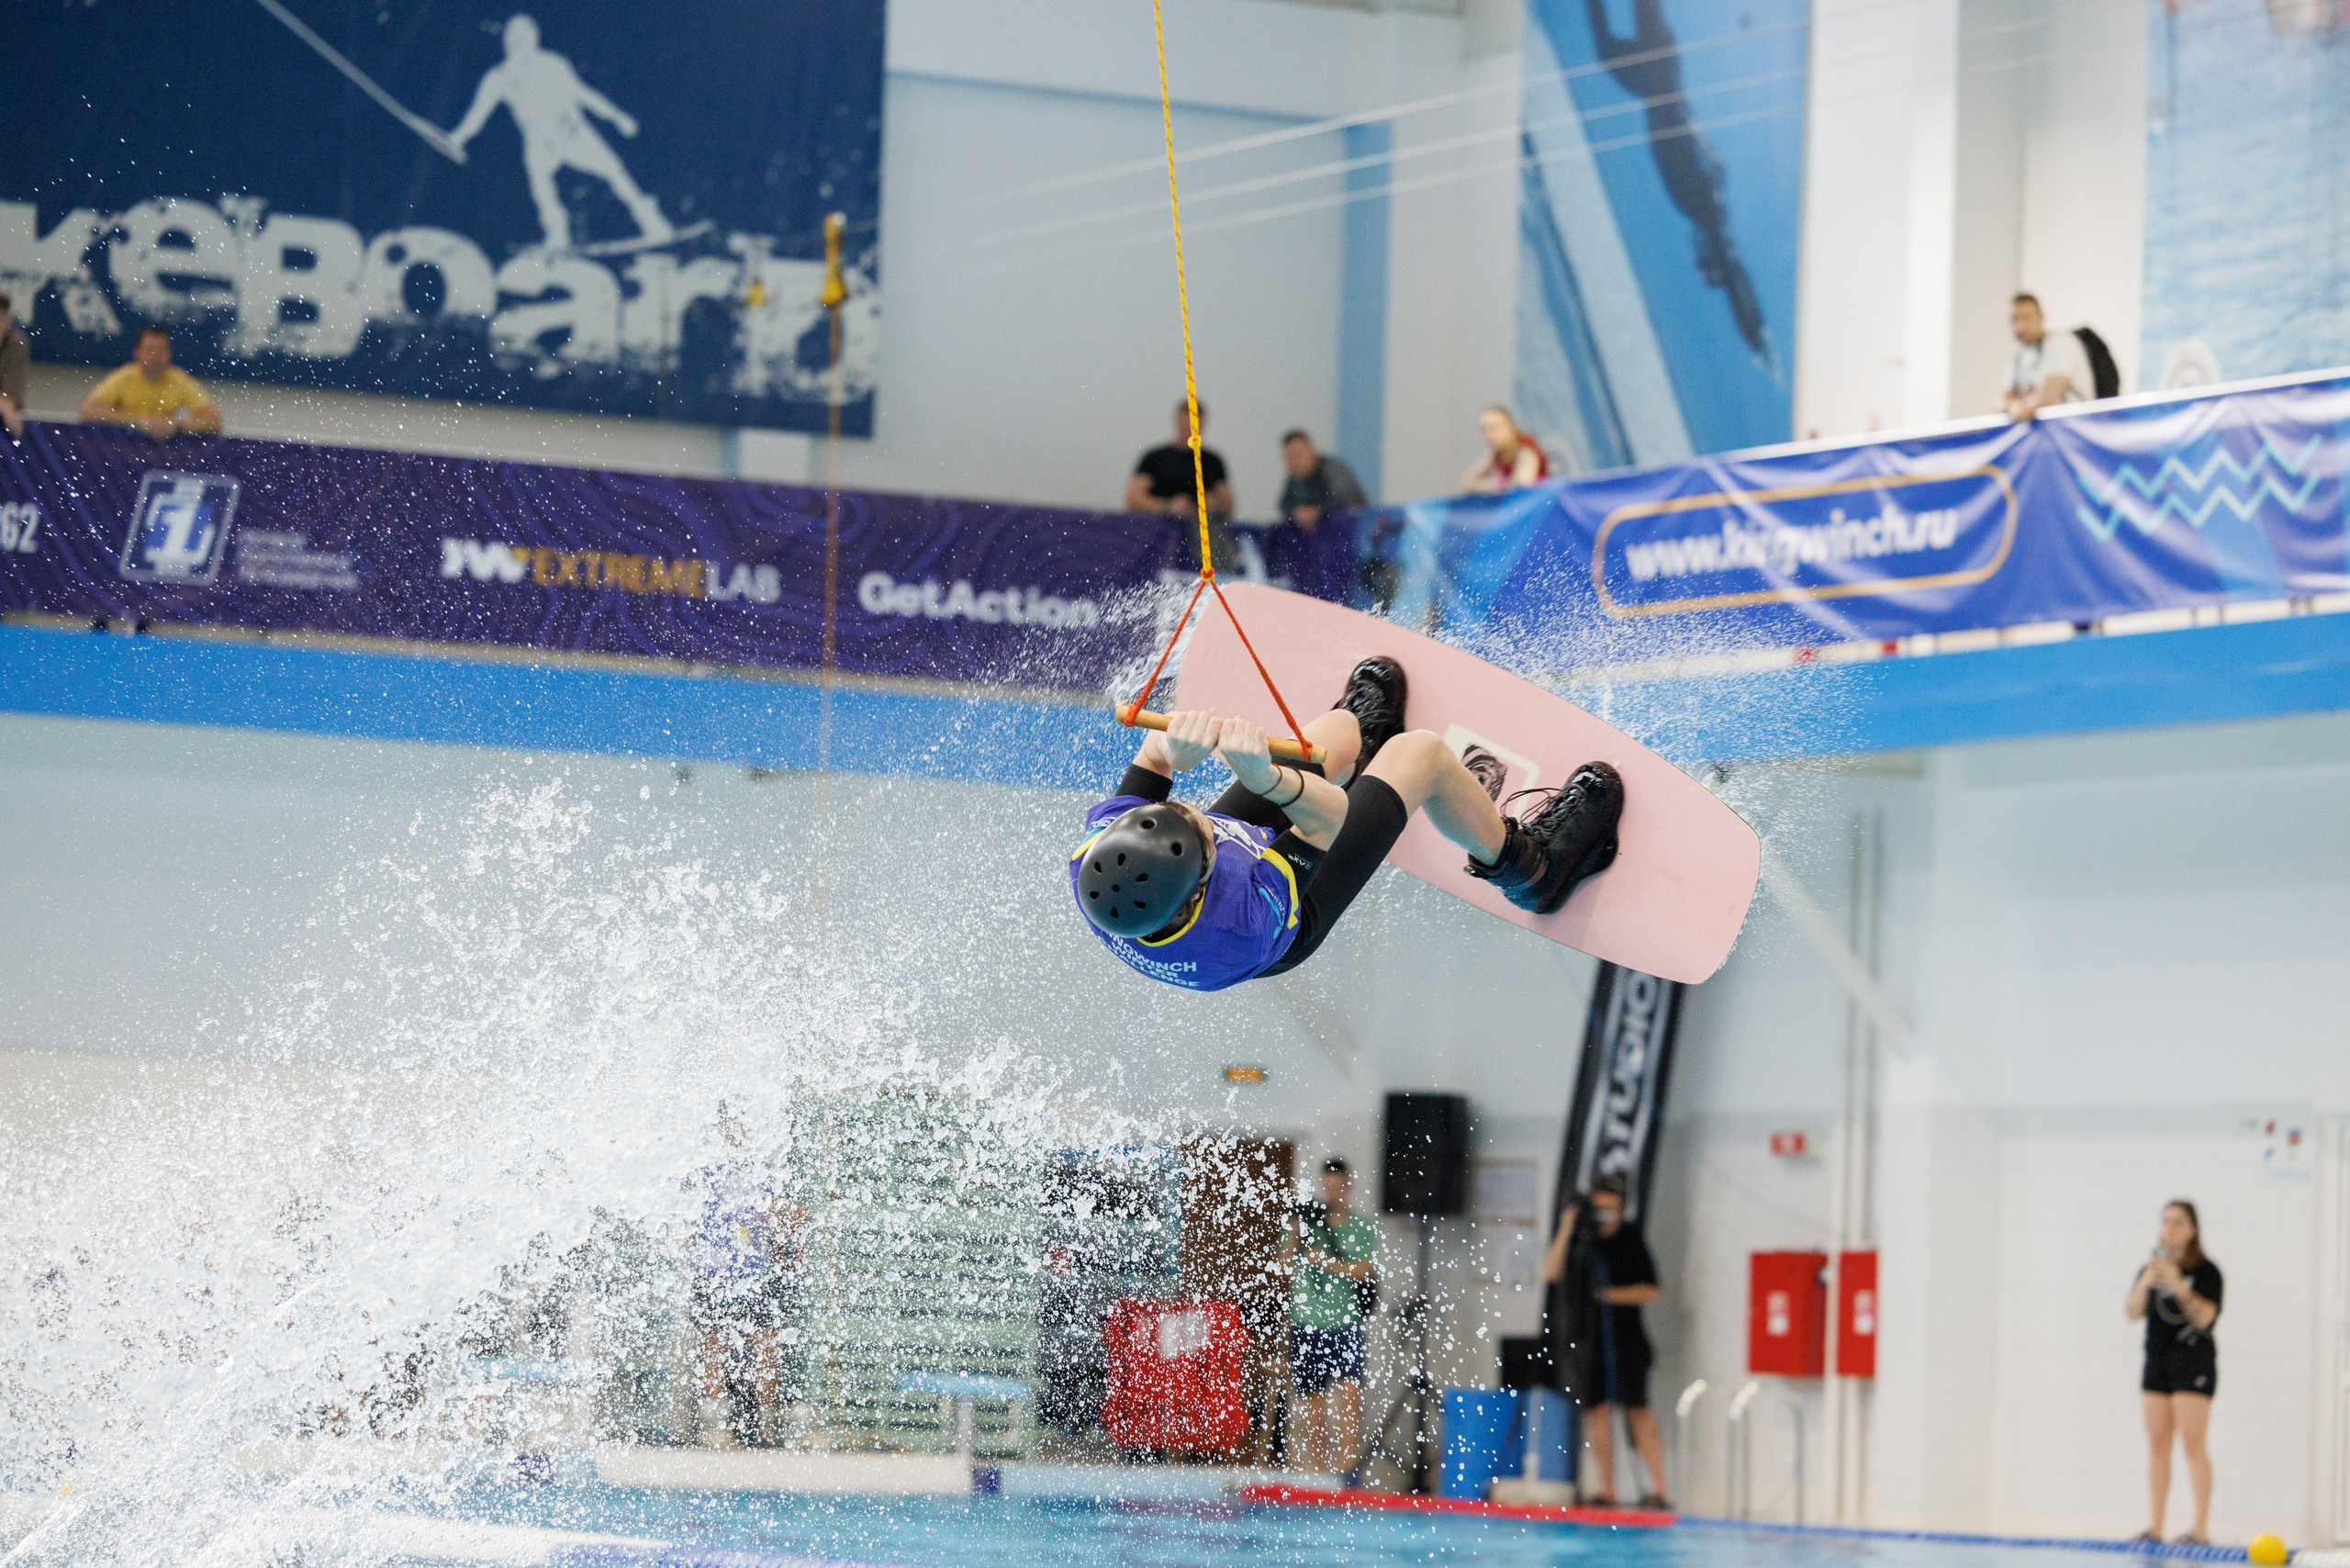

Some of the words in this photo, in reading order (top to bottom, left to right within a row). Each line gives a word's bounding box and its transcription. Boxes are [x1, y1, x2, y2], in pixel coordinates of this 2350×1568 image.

[857, 571, 1100, 630] GetAction
[1107, 931, 1197, 972] NGWINCH
[1596, 969, 1658, 1176] STUDIO
